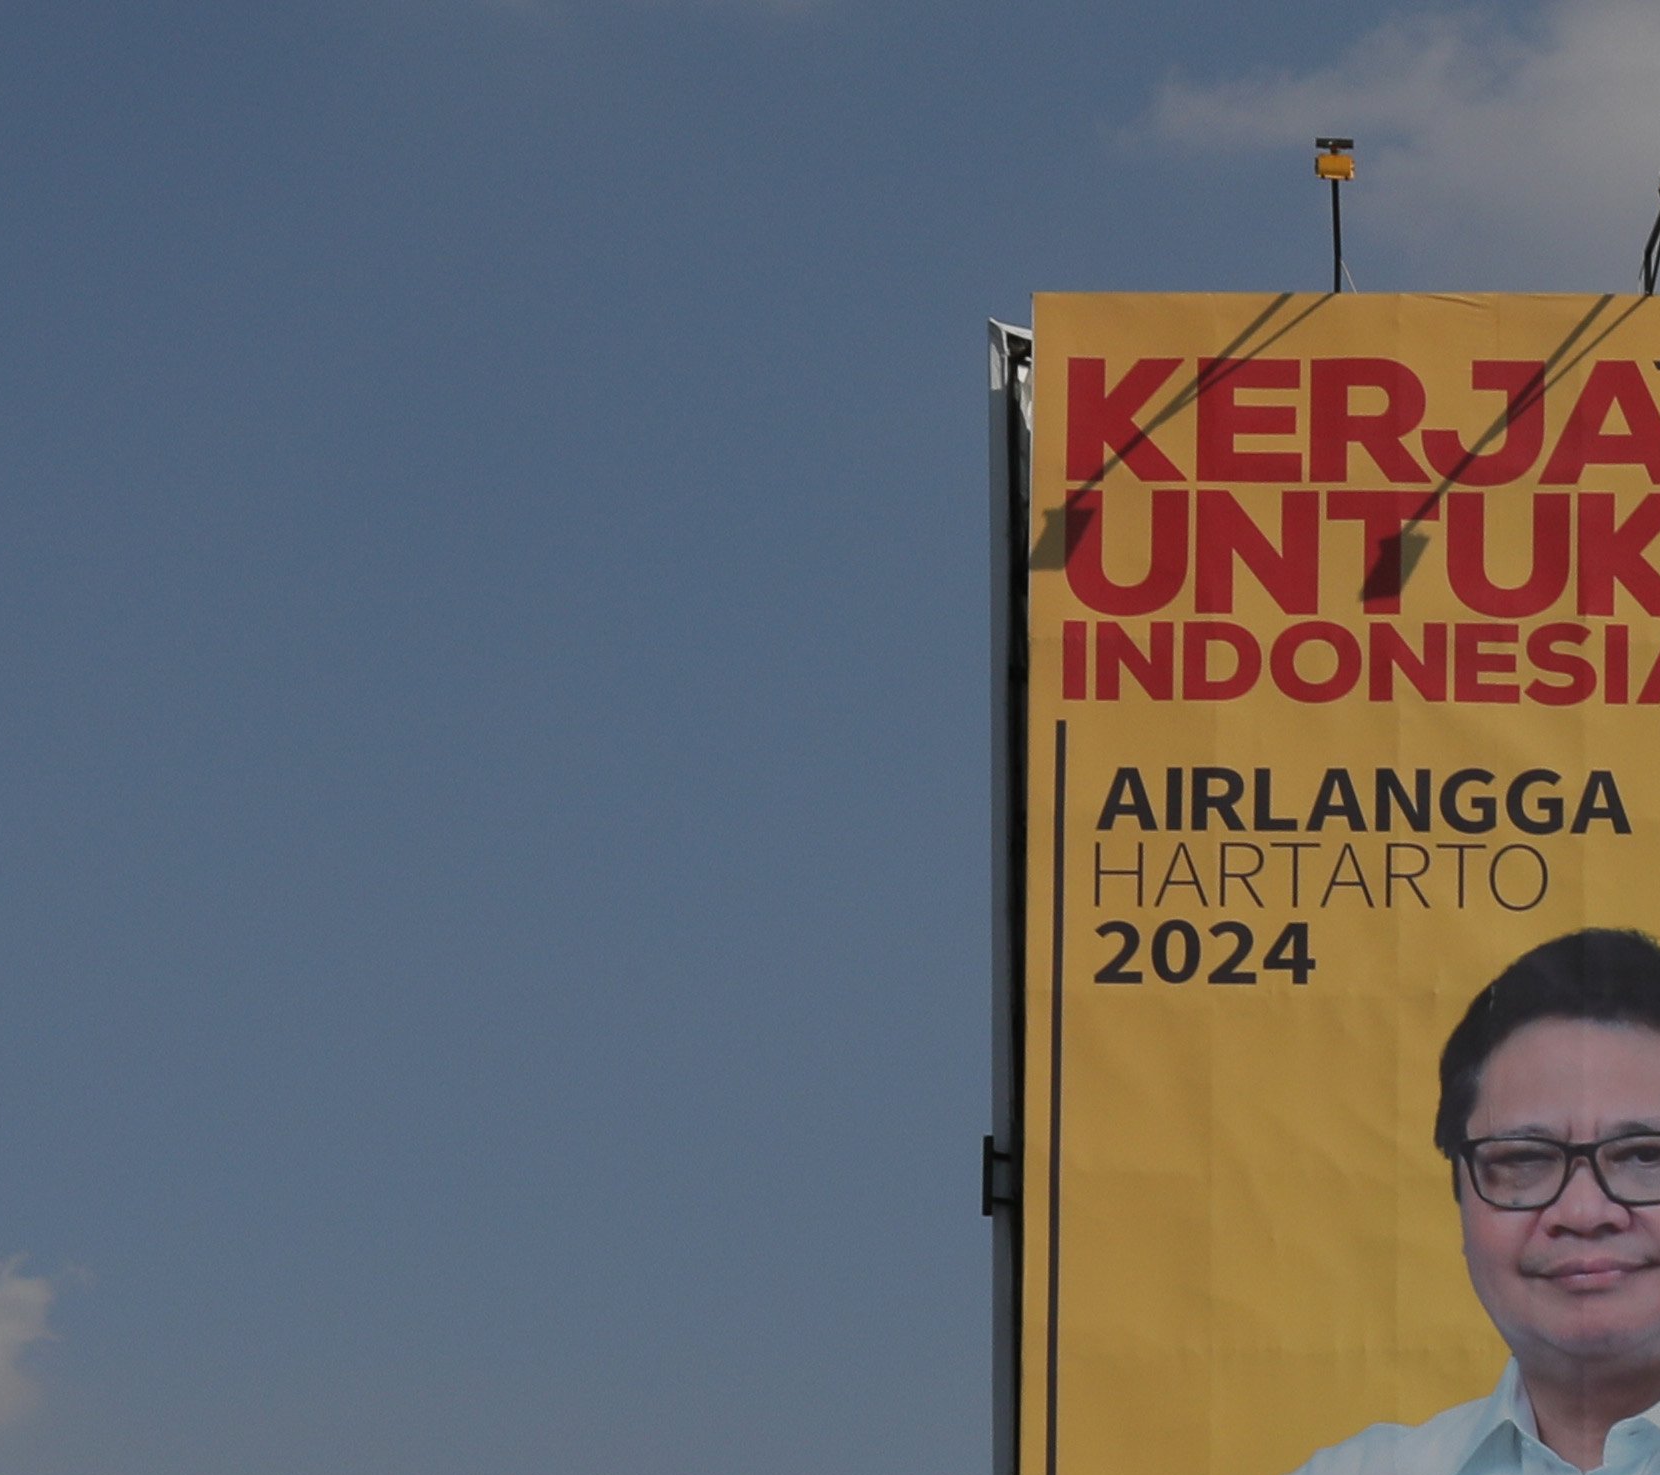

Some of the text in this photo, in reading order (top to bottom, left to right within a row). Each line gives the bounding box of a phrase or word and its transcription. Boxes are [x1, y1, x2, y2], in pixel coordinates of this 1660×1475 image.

[1096, 766, 1632, 835] AIRLANGGA
[1094, 841, 1549, 911] HARTARTO
[1094, 920, 1316, 985] 2024
